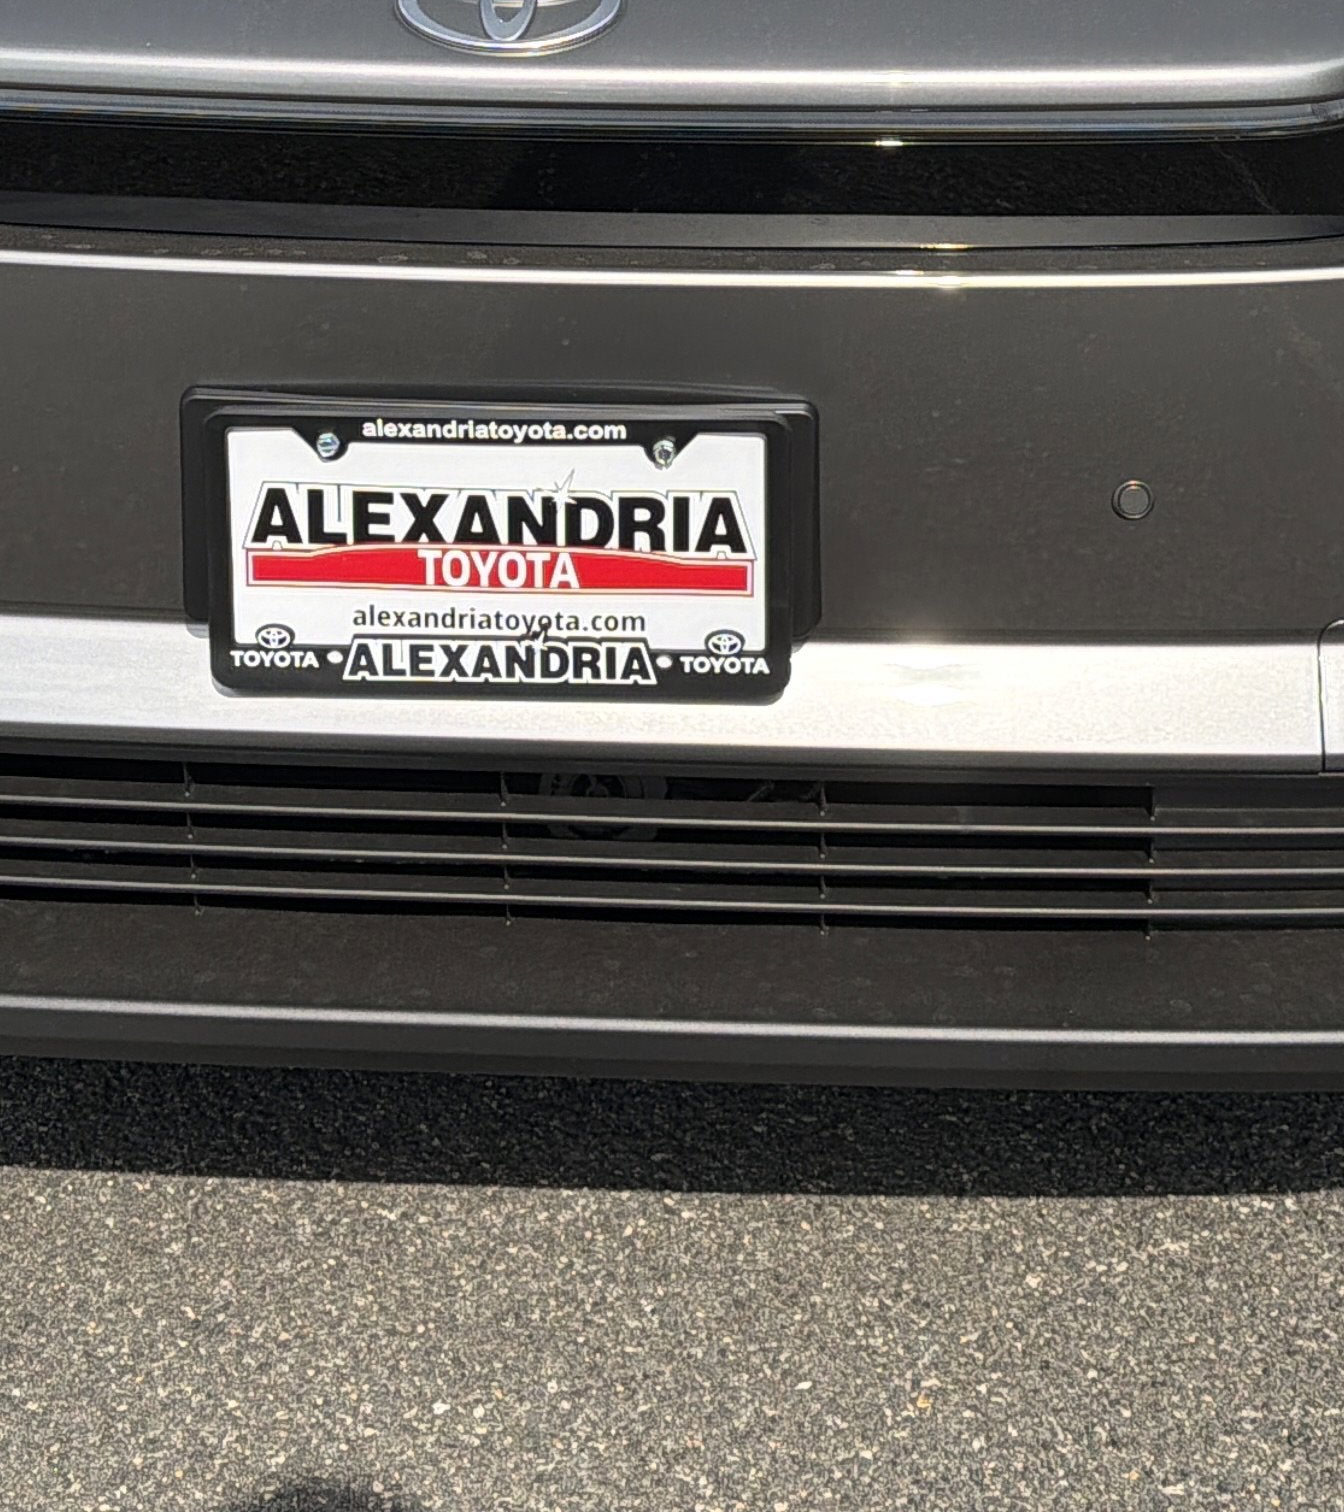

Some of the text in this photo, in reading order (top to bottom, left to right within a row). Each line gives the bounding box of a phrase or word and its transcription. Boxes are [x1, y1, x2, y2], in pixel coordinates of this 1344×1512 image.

[361, 418, 628, 443] alexandriatoyota.com
[248, 486, 754, 556] ALEXANDRIA
[417, 548, 580, 590] TOYOTA
[352, 605, 647, 635] alexandriatoyota.com
[230, 641, 771, 682] TOYOTA ALEXANDRIA TOYOTA
